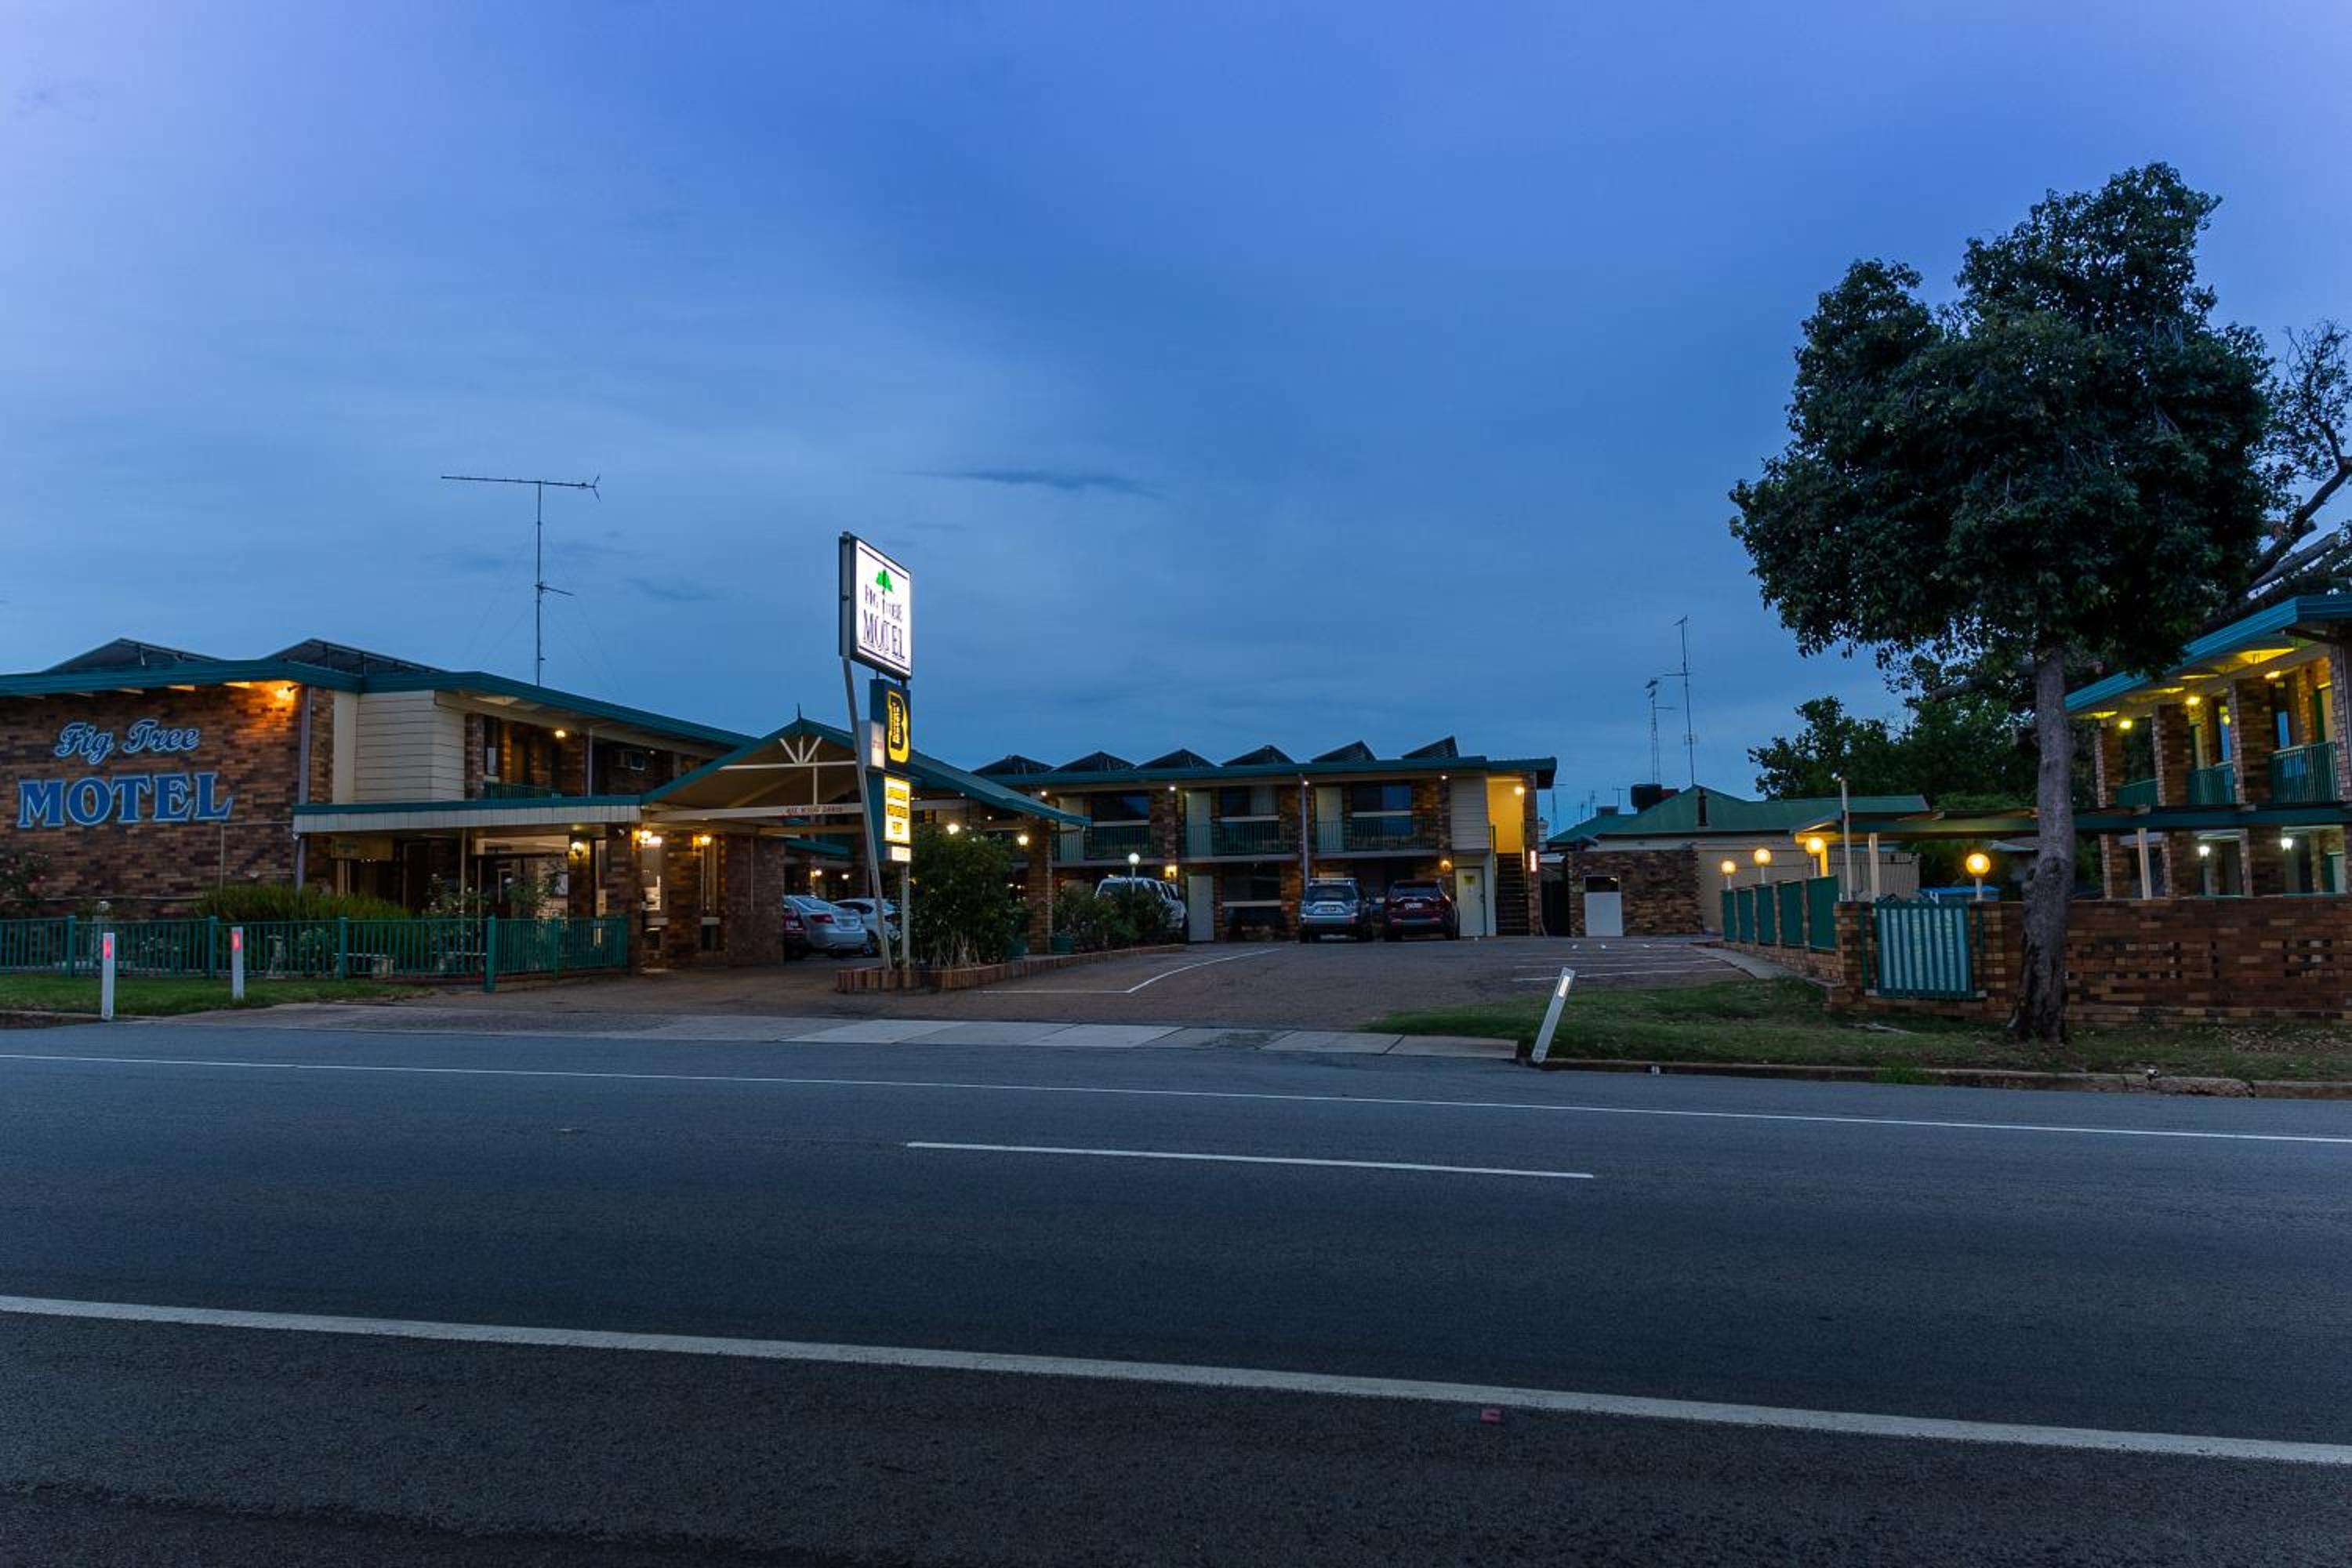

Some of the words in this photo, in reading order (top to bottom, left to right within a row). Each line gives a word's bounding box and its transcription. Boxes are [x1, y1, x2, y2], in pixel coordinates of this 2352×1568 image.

[863, 609, 906, 661] MOTEL
[54, 720, 114, 765] Fig
[122, 717, 201, 753] Tree
[16, 771, 234, 829] MOTEL
